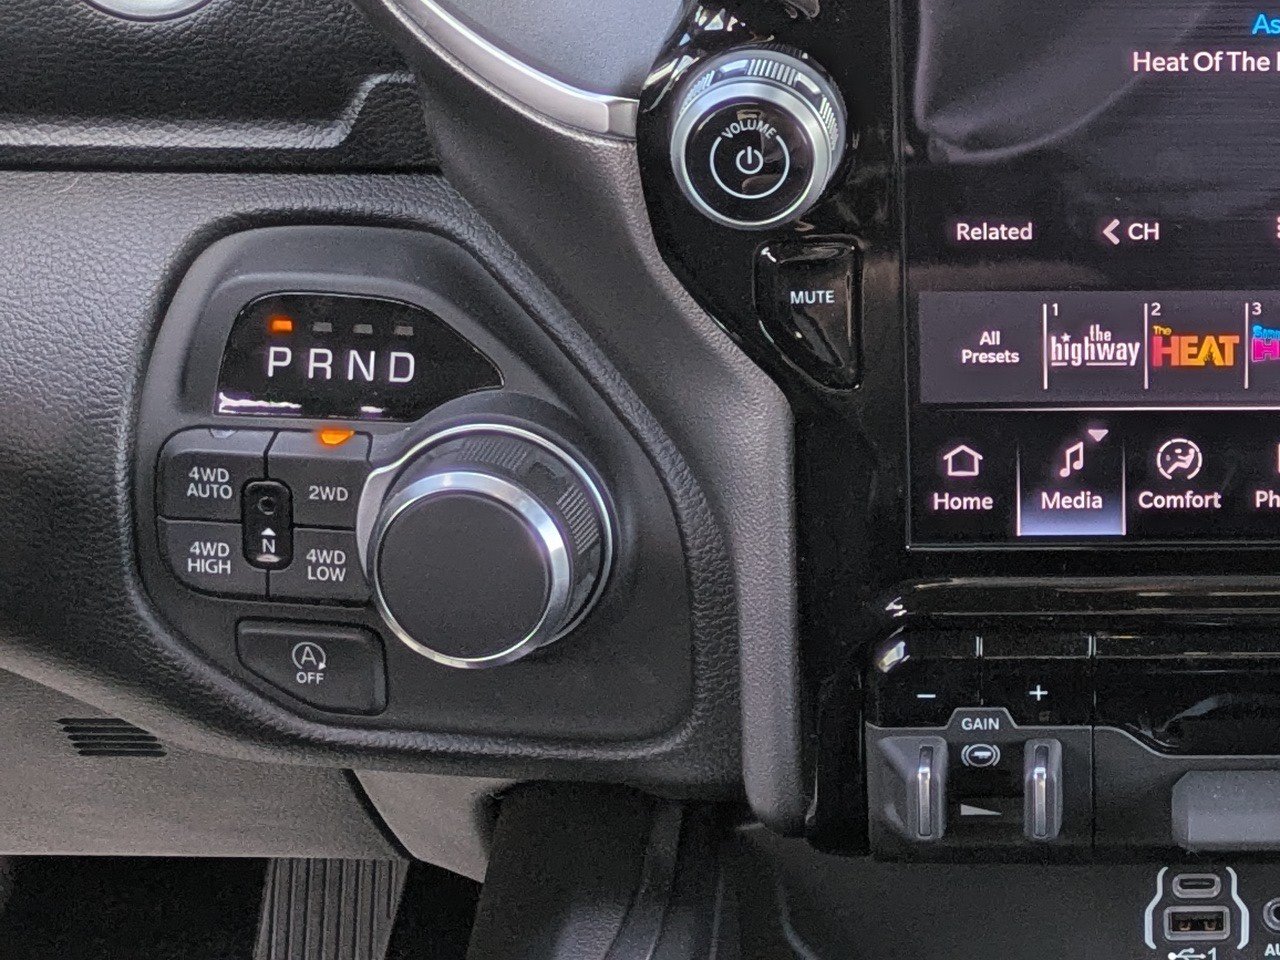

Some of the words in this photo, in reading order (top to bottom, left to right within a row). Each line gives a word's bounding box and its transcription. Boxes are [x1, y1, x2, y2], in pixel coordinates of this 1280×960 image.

[1132, 51, 1189, 72] Heat
[1192, 50, 1224, 72] Of
[1225, 51, 1271, 72] The
[721, 119, 777, 140] VOLUME
[956, 222, 1033, 241] Related
[1127, 222, 1161, 241] CH
[790, 290, 835, 304] MUTE
[1051, 303, 1059, 317] 1
[1151, 302, 1162, 316] 2
[1251, 302, 1262, 316] 3
[979, 331, 1001, 346] All
[1090, 325, 1112, 342] the
[1153, 325, 1172, 336] The
[961, 349, 1020, 365] Presets
[1051, 335, 1141, 367] highway
[1152, 334, 1240, 367] HEAT
[188, 465, 230, 483] 4WD
[186, 483, 233, 500] AUTO
[308, 485, 349, 502] 2WD
[933, 492, 994, 511] Home
[1041, 491, 1103, 510] Media
[1137, 491, 1222, 510] Comfort
[189, 542, 230, 558] 4WD
[261, 538, 276, 554] N
[306, 548, 346, 565] 4WD
[187, 558, 231, 575] HIGH
[307, 565, 346, 582] LOW
[296, 671, 324, 685] OFF
[961, 717, 999, 731] GAIN
[1207, 947, 1217, 960] 1
